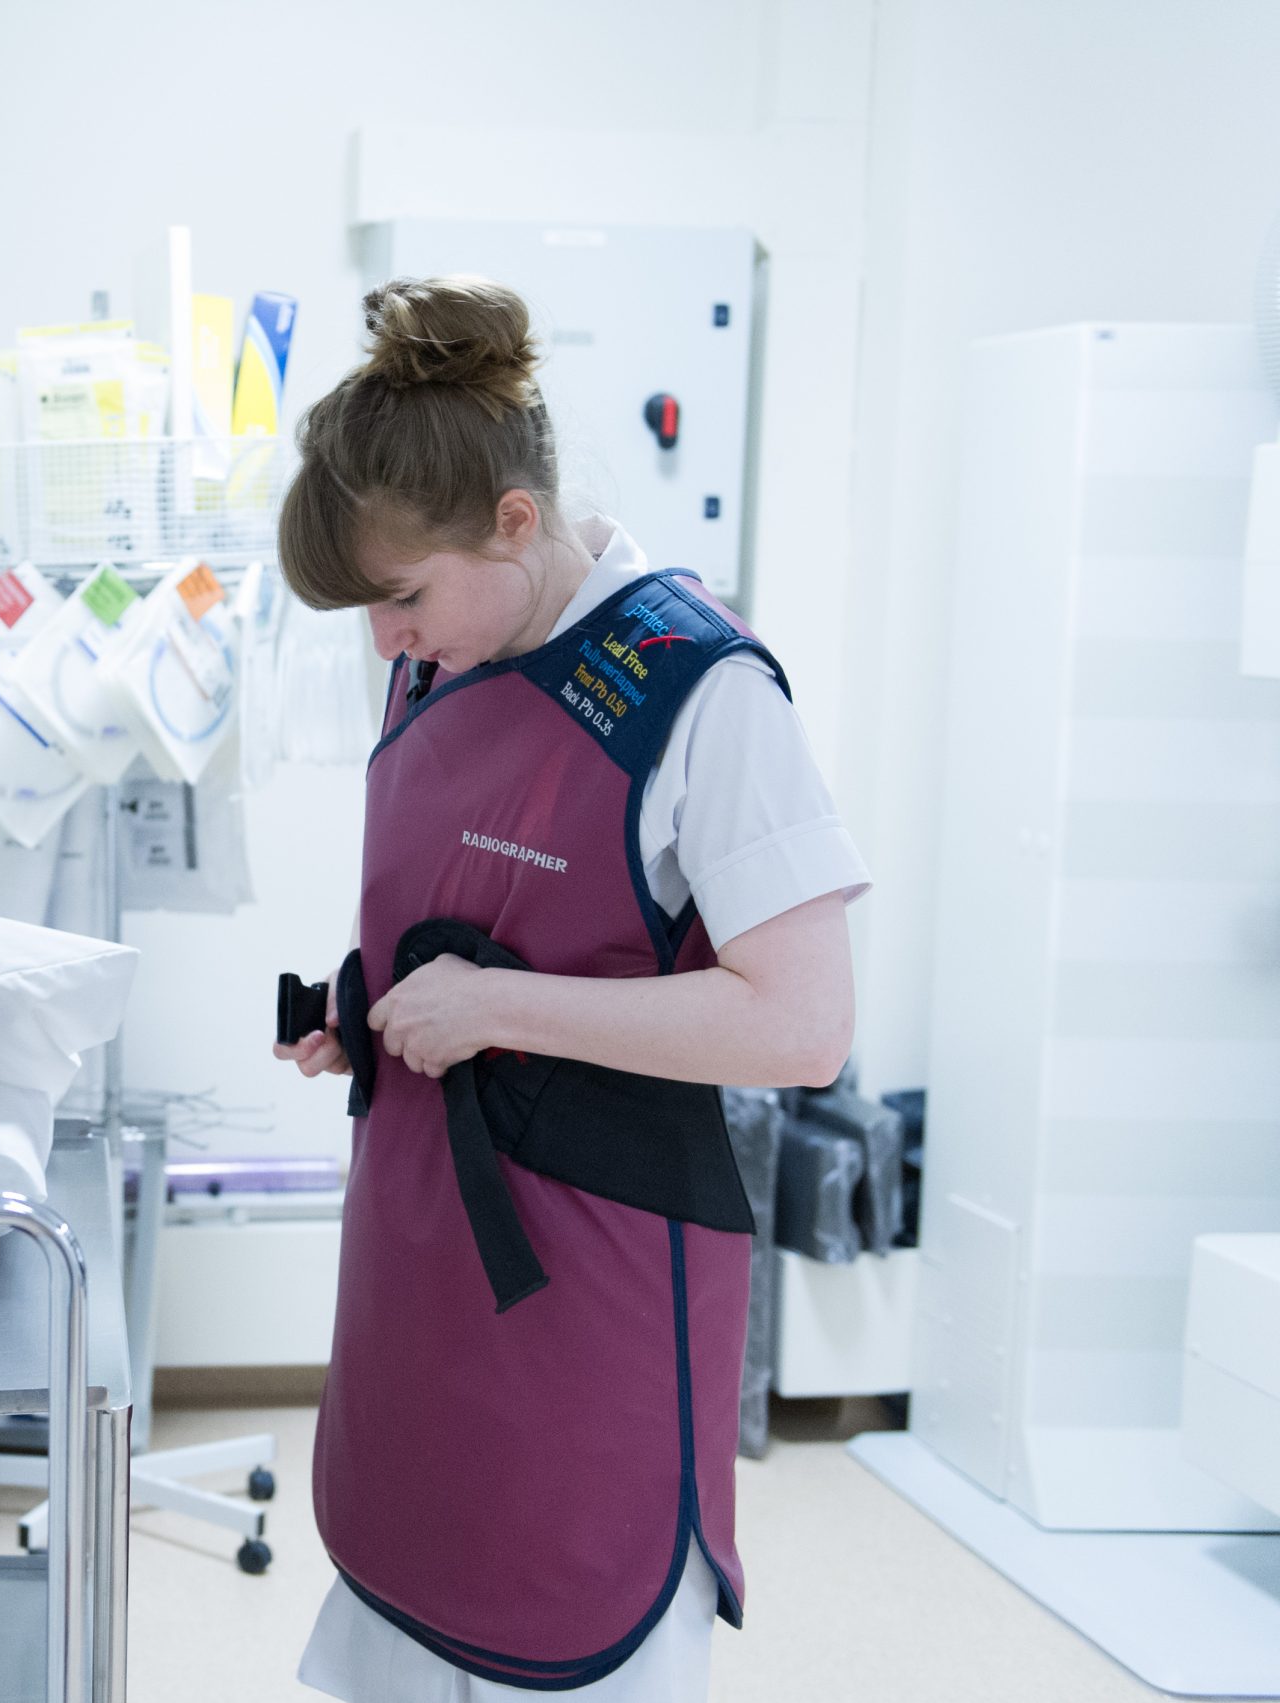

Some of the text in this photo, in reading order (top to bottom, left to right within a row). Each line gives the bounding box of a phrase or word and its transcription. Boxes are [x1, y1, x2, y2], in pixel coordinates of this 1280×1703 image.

[579, 639, 647, 706] Fully overlapped
[602, 632, 648, 680] Lead Free
[560, 681, 614, 736] Back Pb 0.35
[574, 663, 628, 718] Front Pb 0.50
[461, 830, 568, 873] RADIOGRAPHER
